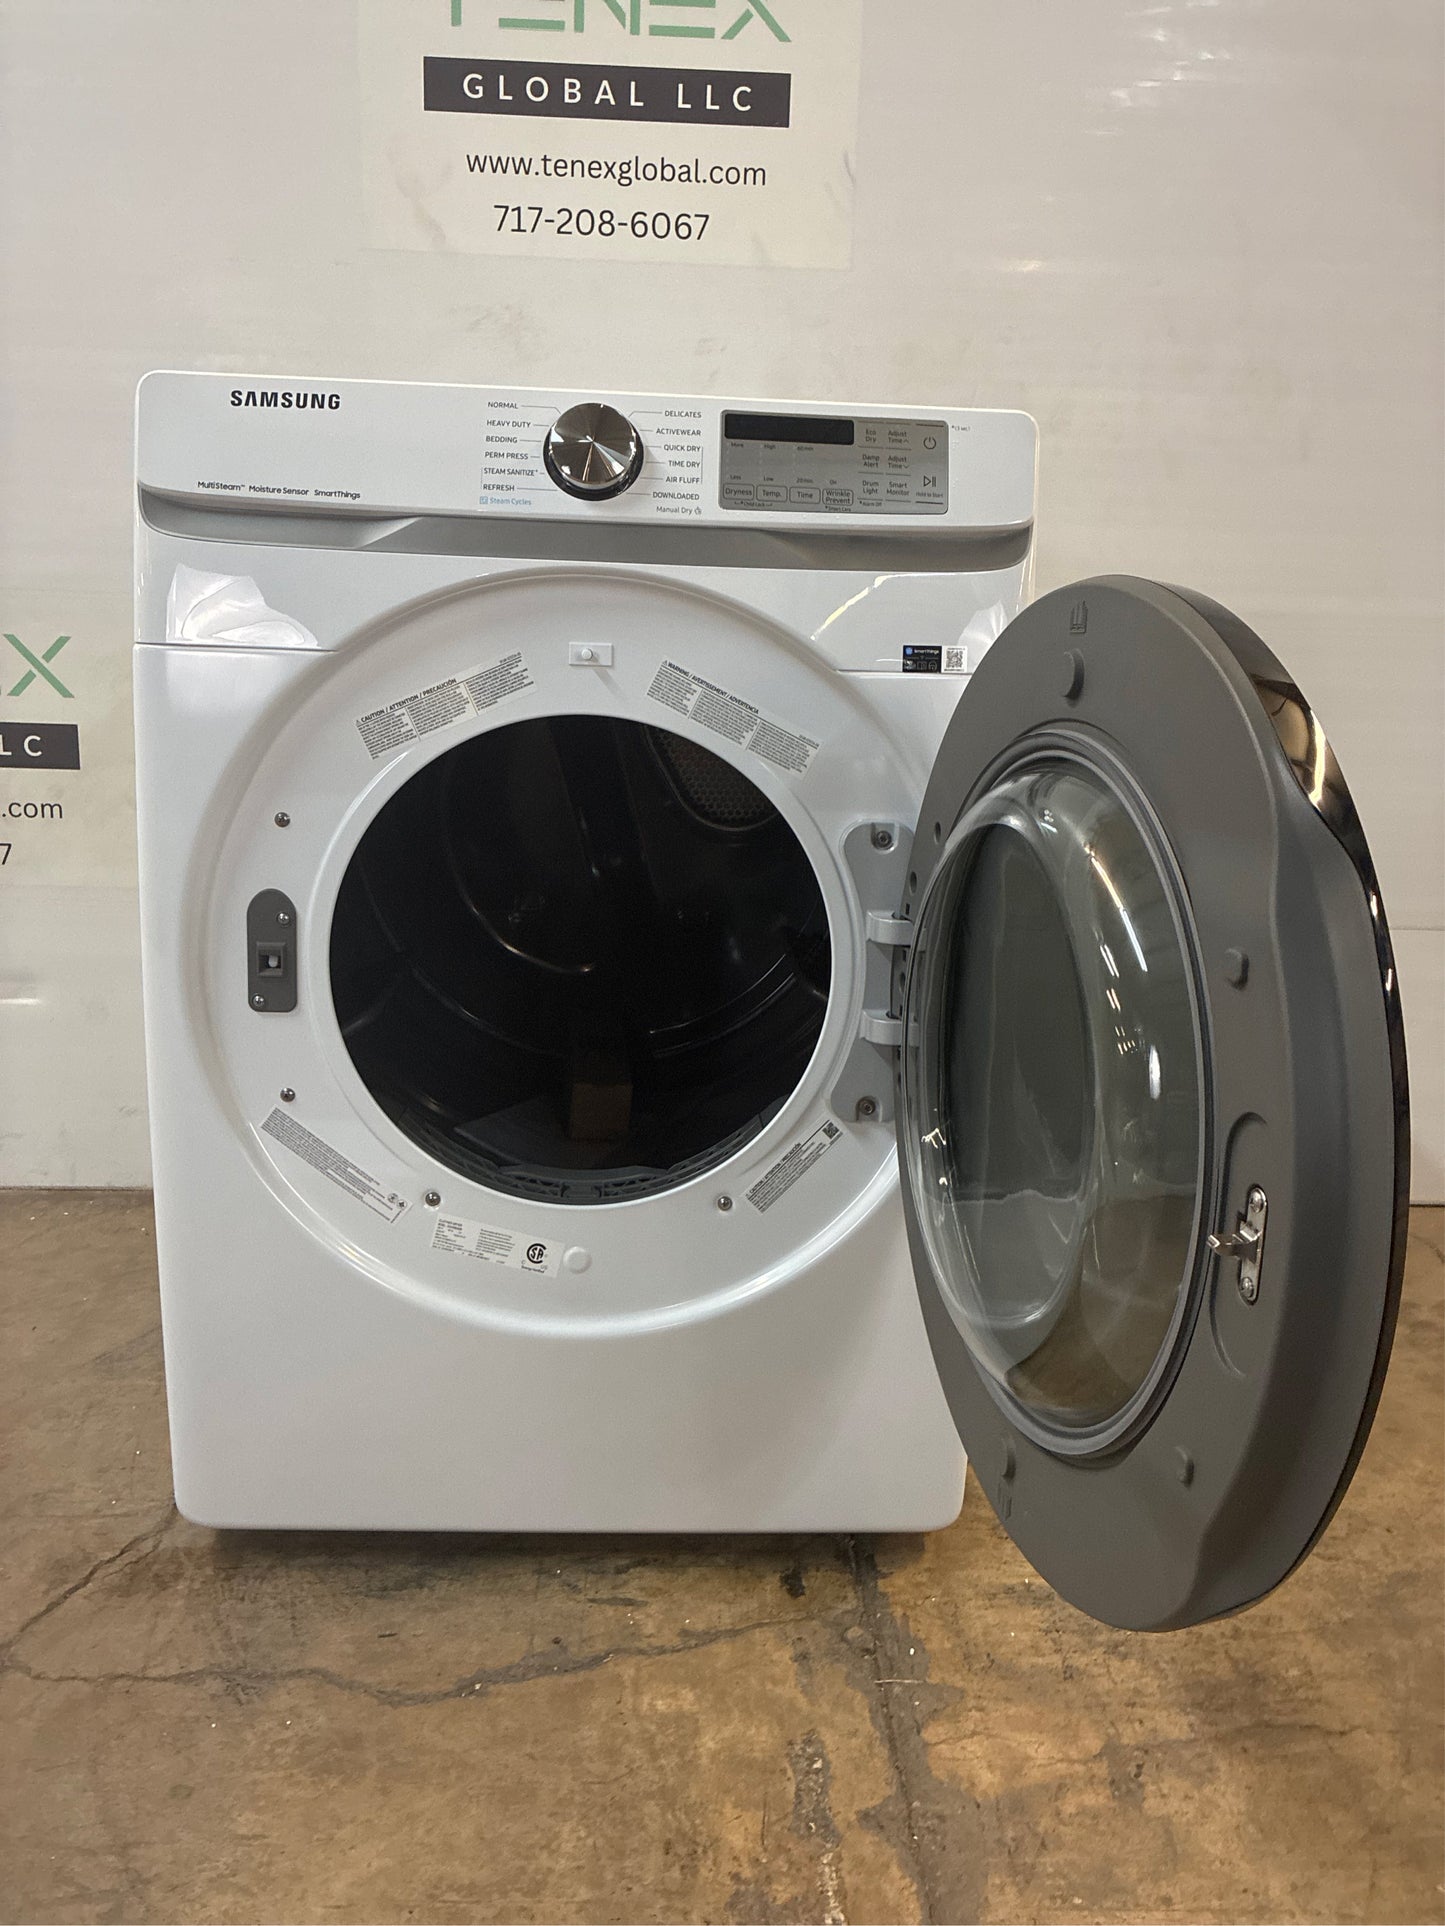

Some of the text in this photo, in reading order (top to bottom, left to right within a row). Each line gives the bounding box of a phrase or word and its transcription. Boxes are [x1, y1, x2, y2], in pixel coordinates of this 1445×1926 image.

[462, 73, 753, 112] GLOBAL LLC
[466, 152, 767, 187] www.tenexglobal.com
[493, 205, 709, 241] 717-208-6067
[230, 390, 341, 410] SAMSUNG
[488, 401, 519, 410] NORMAL
[664, 410, 702, 419] DELICATES
[487, 420, 531, 429] HEAVY DUTY
[656, 428, 702, 436] ACTIVEWEAR
[888, 430, 908, 438] Adjust
[486, 436, 518, 444] BEDDING
[664, 444, 701, 453] QUICK DRY
[485, 452, 529, 460] PERM PRESS
[668, 460, 701, 468] TIME DRY
[666, 476, 700, 484] AIR FLUFF
[248, 485, 282, 494] Moisture
[282, 487, 310, 496] Sensor
[314, 490, 361, 500] SmartThings
[483, 484, 515, 492] REFRESH
[725, 488, 753, 496] Dryness
[652, 492, 700, 501] DOWNLOADED
[490, 497, 532, 506] Steam Cycles
[656, 506, 693, 516] Manual Dry
[667, 662, 690, 678] WARNING
[692, 674, 728, 698] AVERTISSEMENT
[729, 694, 760, 715] ADVERTENCIA
[360, 708, 385, 723] CAUTION
[389, 694, 418, 711] ATTENTION
[422, 678, 457, 697] PRECAUCIÓN
[2, 802, 63, 819] .com
